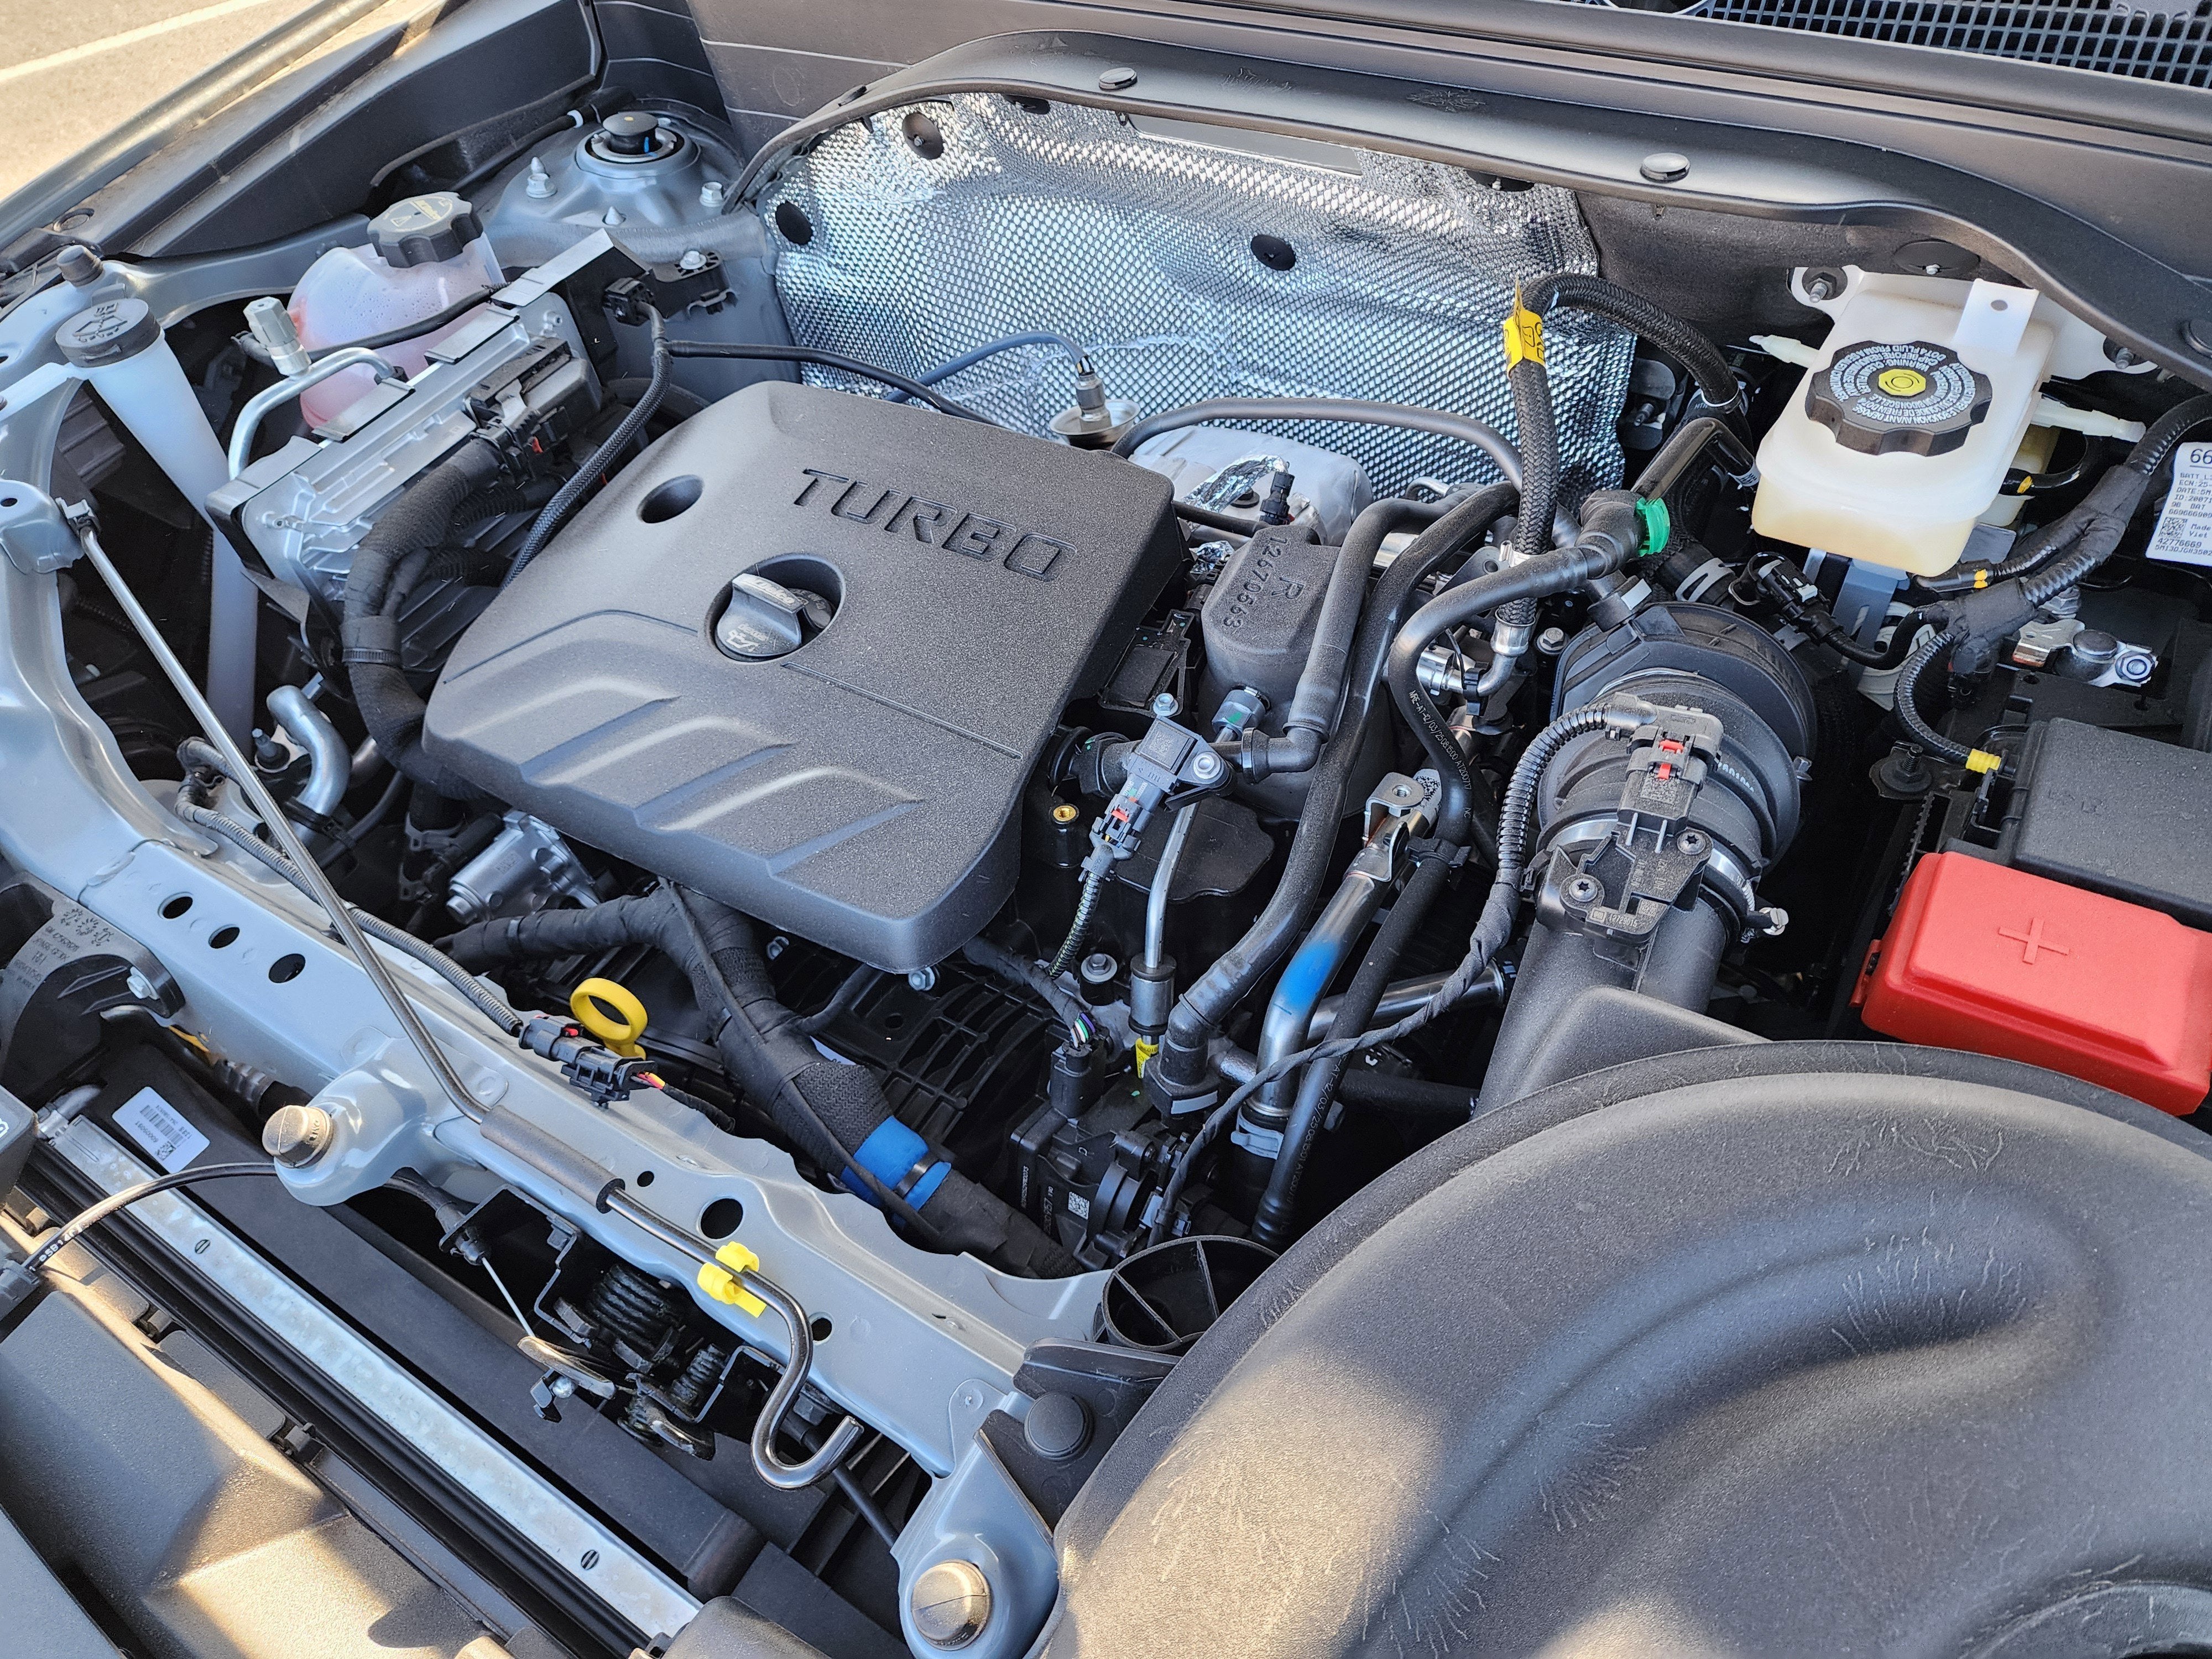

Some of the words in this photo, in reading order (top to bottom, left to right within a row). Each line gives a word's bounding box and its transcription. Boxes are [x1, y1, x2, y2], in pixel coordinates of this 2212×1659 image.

[1863, 345, 1891, 356] FROM
[1881, 352, 1919, 361] BEFORE
[1882, 359, 1930, 372] WARNING:
[1918, 356, 1938, 366] CAP
[1884, 415, 1912, 425] AVANT
[793, 468, 1078, 581] TURBO
[1223, 536, 1287, 628] 12670563
[1455, 760, 1472, 790] AT200717
